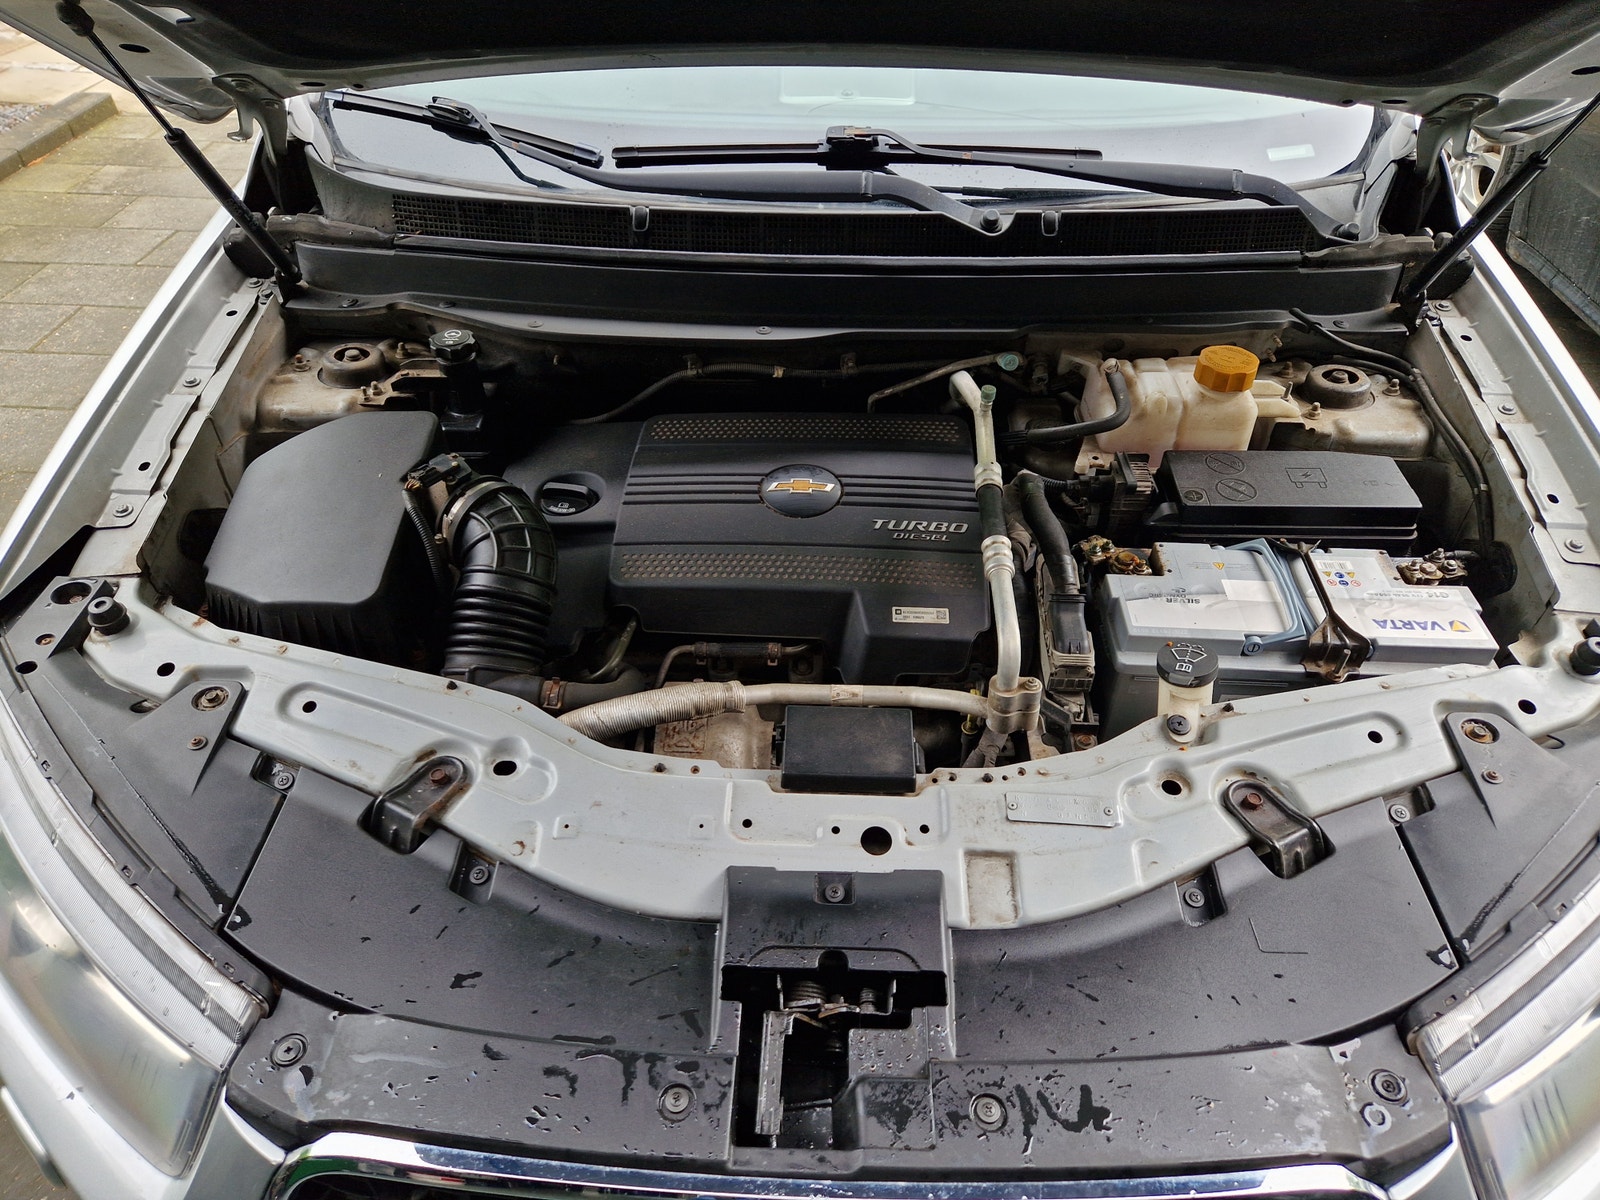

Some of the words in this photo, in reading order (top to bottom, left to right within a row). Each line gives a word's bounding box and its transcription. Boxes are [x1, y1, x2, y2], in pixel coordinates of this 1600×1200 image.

[872, 519, 969, 533] TURBO
[893, 532, 951, 542] DIESEL
[1372, 618, 1447, 633] VARTA
